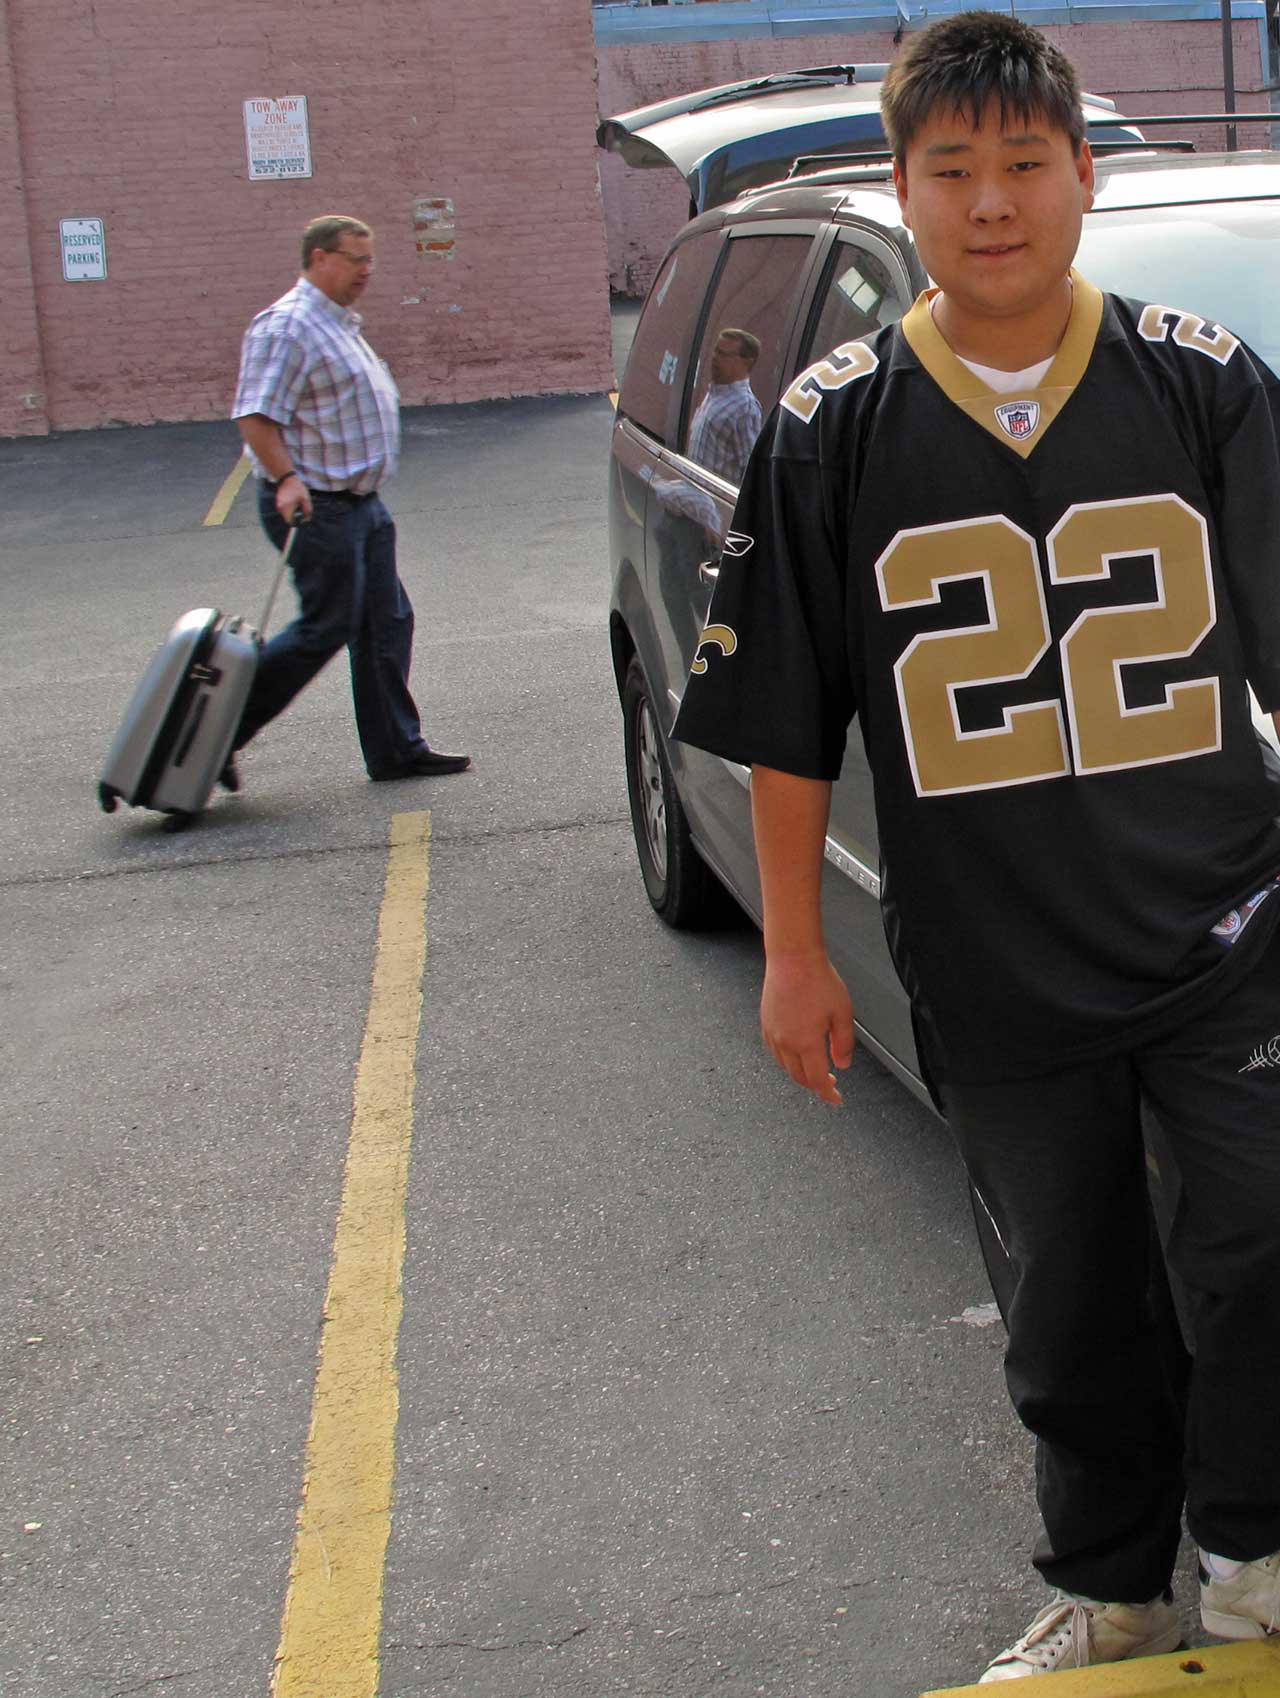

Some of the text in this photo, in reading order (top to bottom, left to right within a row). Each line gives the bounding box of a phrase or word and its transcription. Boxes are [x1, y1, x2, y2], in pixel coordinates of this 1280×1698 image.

[251, 99, 298, 113] TOW AWAY
[265, 113, 287, 125] ZONE
[64, 234, 101, 246] RESERVED
[68, 252, 100, 264] PARKING
[1011, 420, 1030, 432] NFL
[874, 493, 1222, 798] 22
